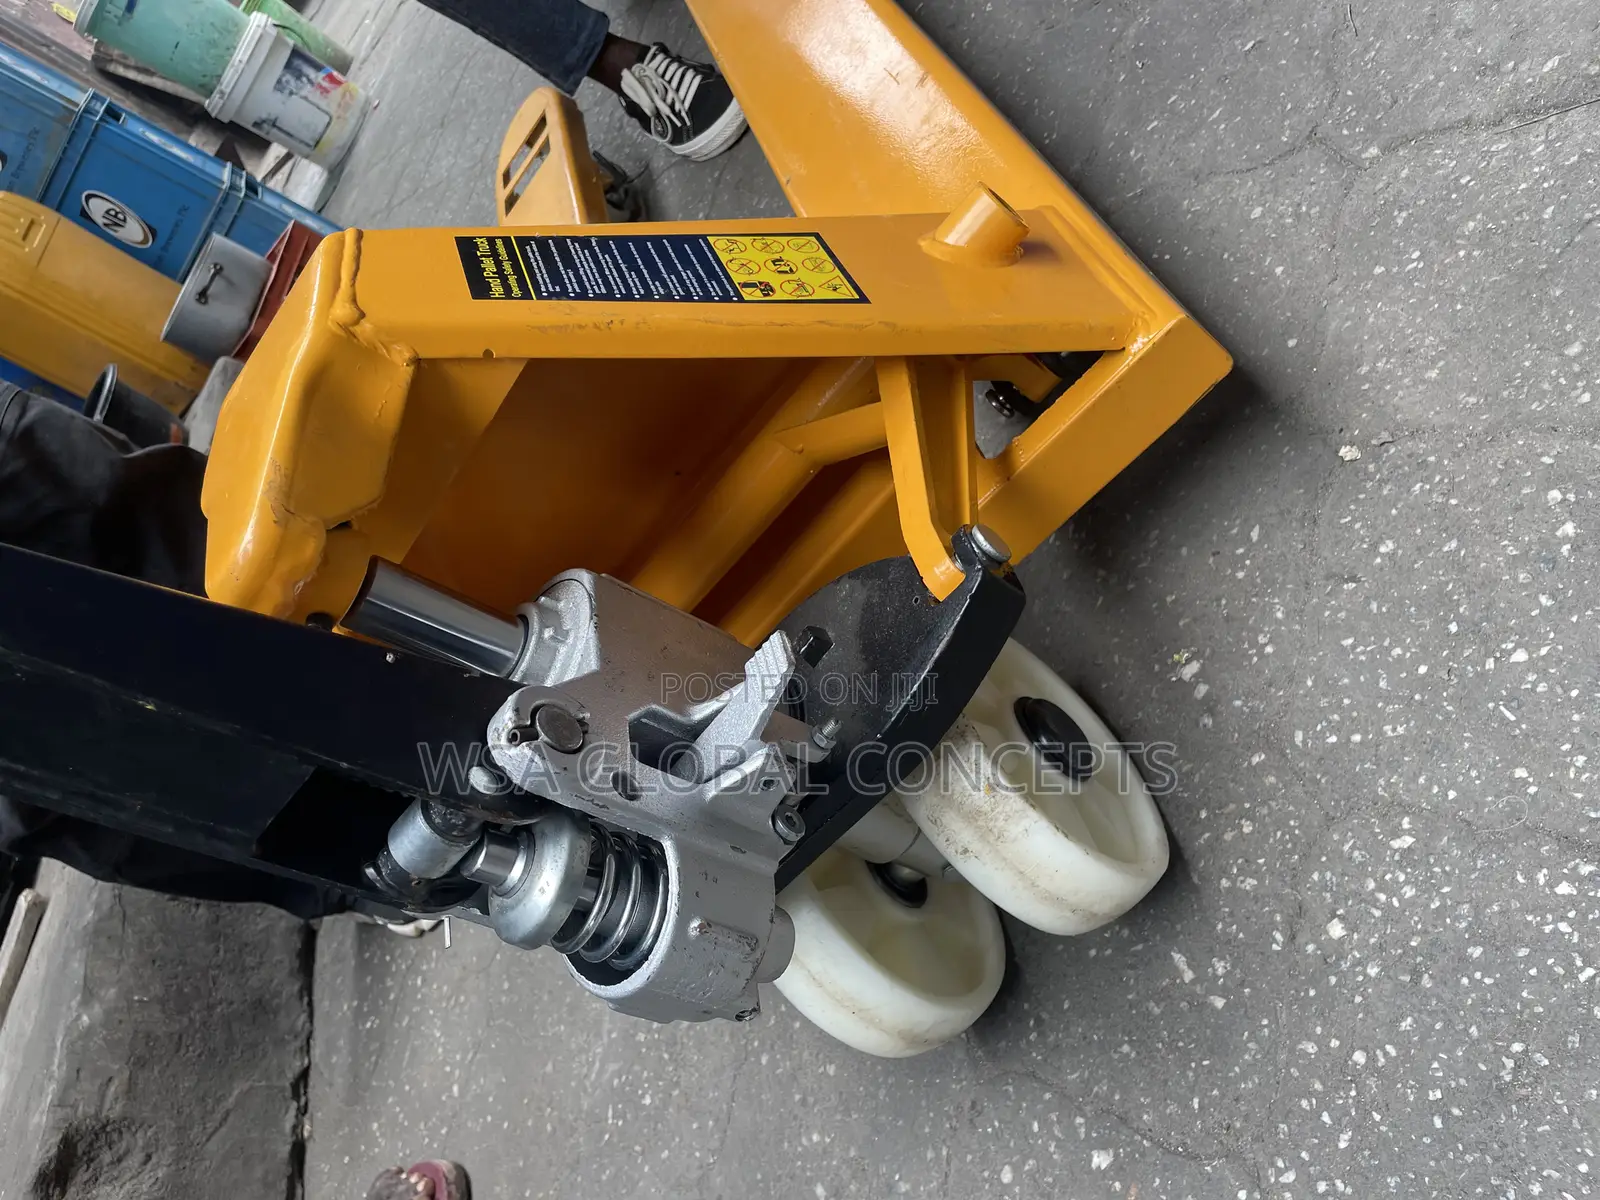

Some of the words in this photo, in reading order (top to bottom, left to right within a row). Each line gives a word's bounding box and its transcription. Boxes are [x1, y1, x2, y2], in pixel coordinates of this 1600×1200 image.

[102, 207, 127, 233] NB
[473, 237, 492, 256] Truck
[494, 238, 509, 260] Guidelines
[479, 257, 498, 276] Pallet
[501, 261, 515, 274] Safety
[485, 278, 505, 297] Hand
[507, 275, 522, 297] Operating
